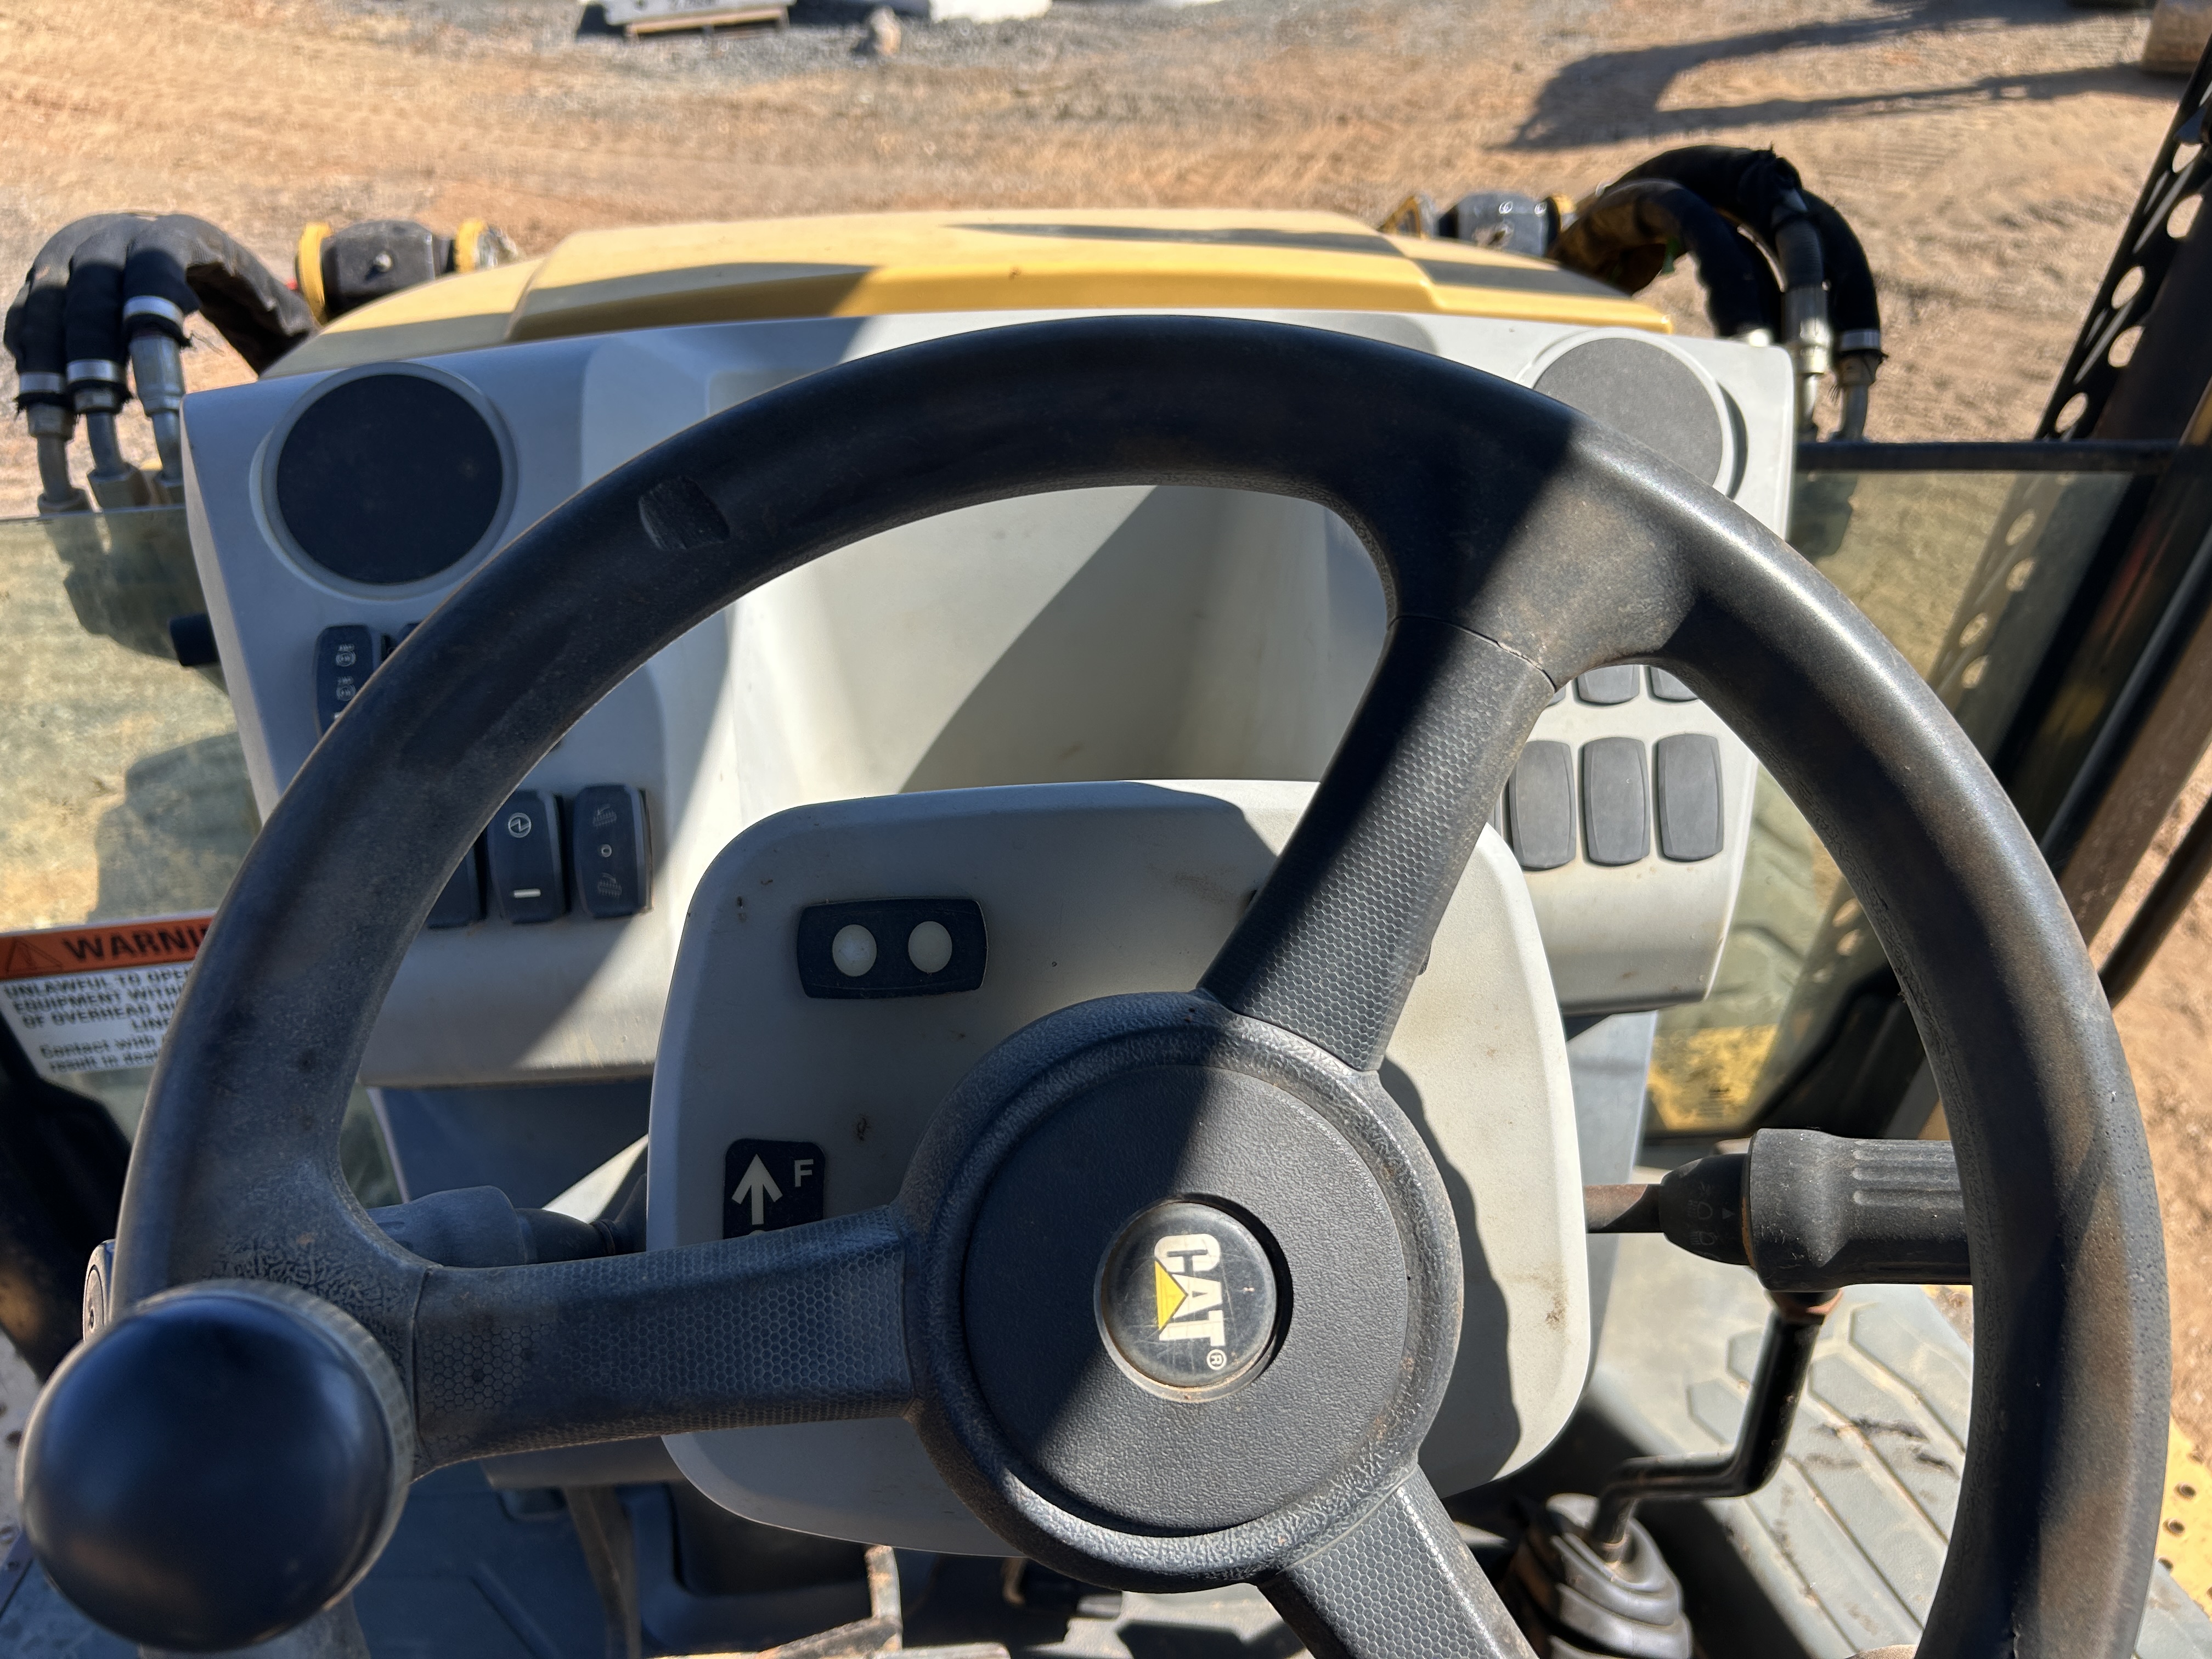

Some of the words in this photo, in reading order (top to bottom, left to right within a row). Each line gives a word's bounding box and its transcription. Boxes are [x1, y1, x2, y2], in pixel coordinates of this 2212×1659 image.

[62, 924, 210, 960] WARNI
[4, 976, 110, 999] UNLAWFUL
[115, 972, 141, 986] TO
[13, 991, 121, 1014] EQUIPMENT
[22, 1015, 44, 1029] OF
[50, 1003, 150, 1026] OVERHEAD
[39, 1039, 109, 1059] Contact
[115, 1035, 155, 1050] with
[794, 1159, 814, 1187] F
